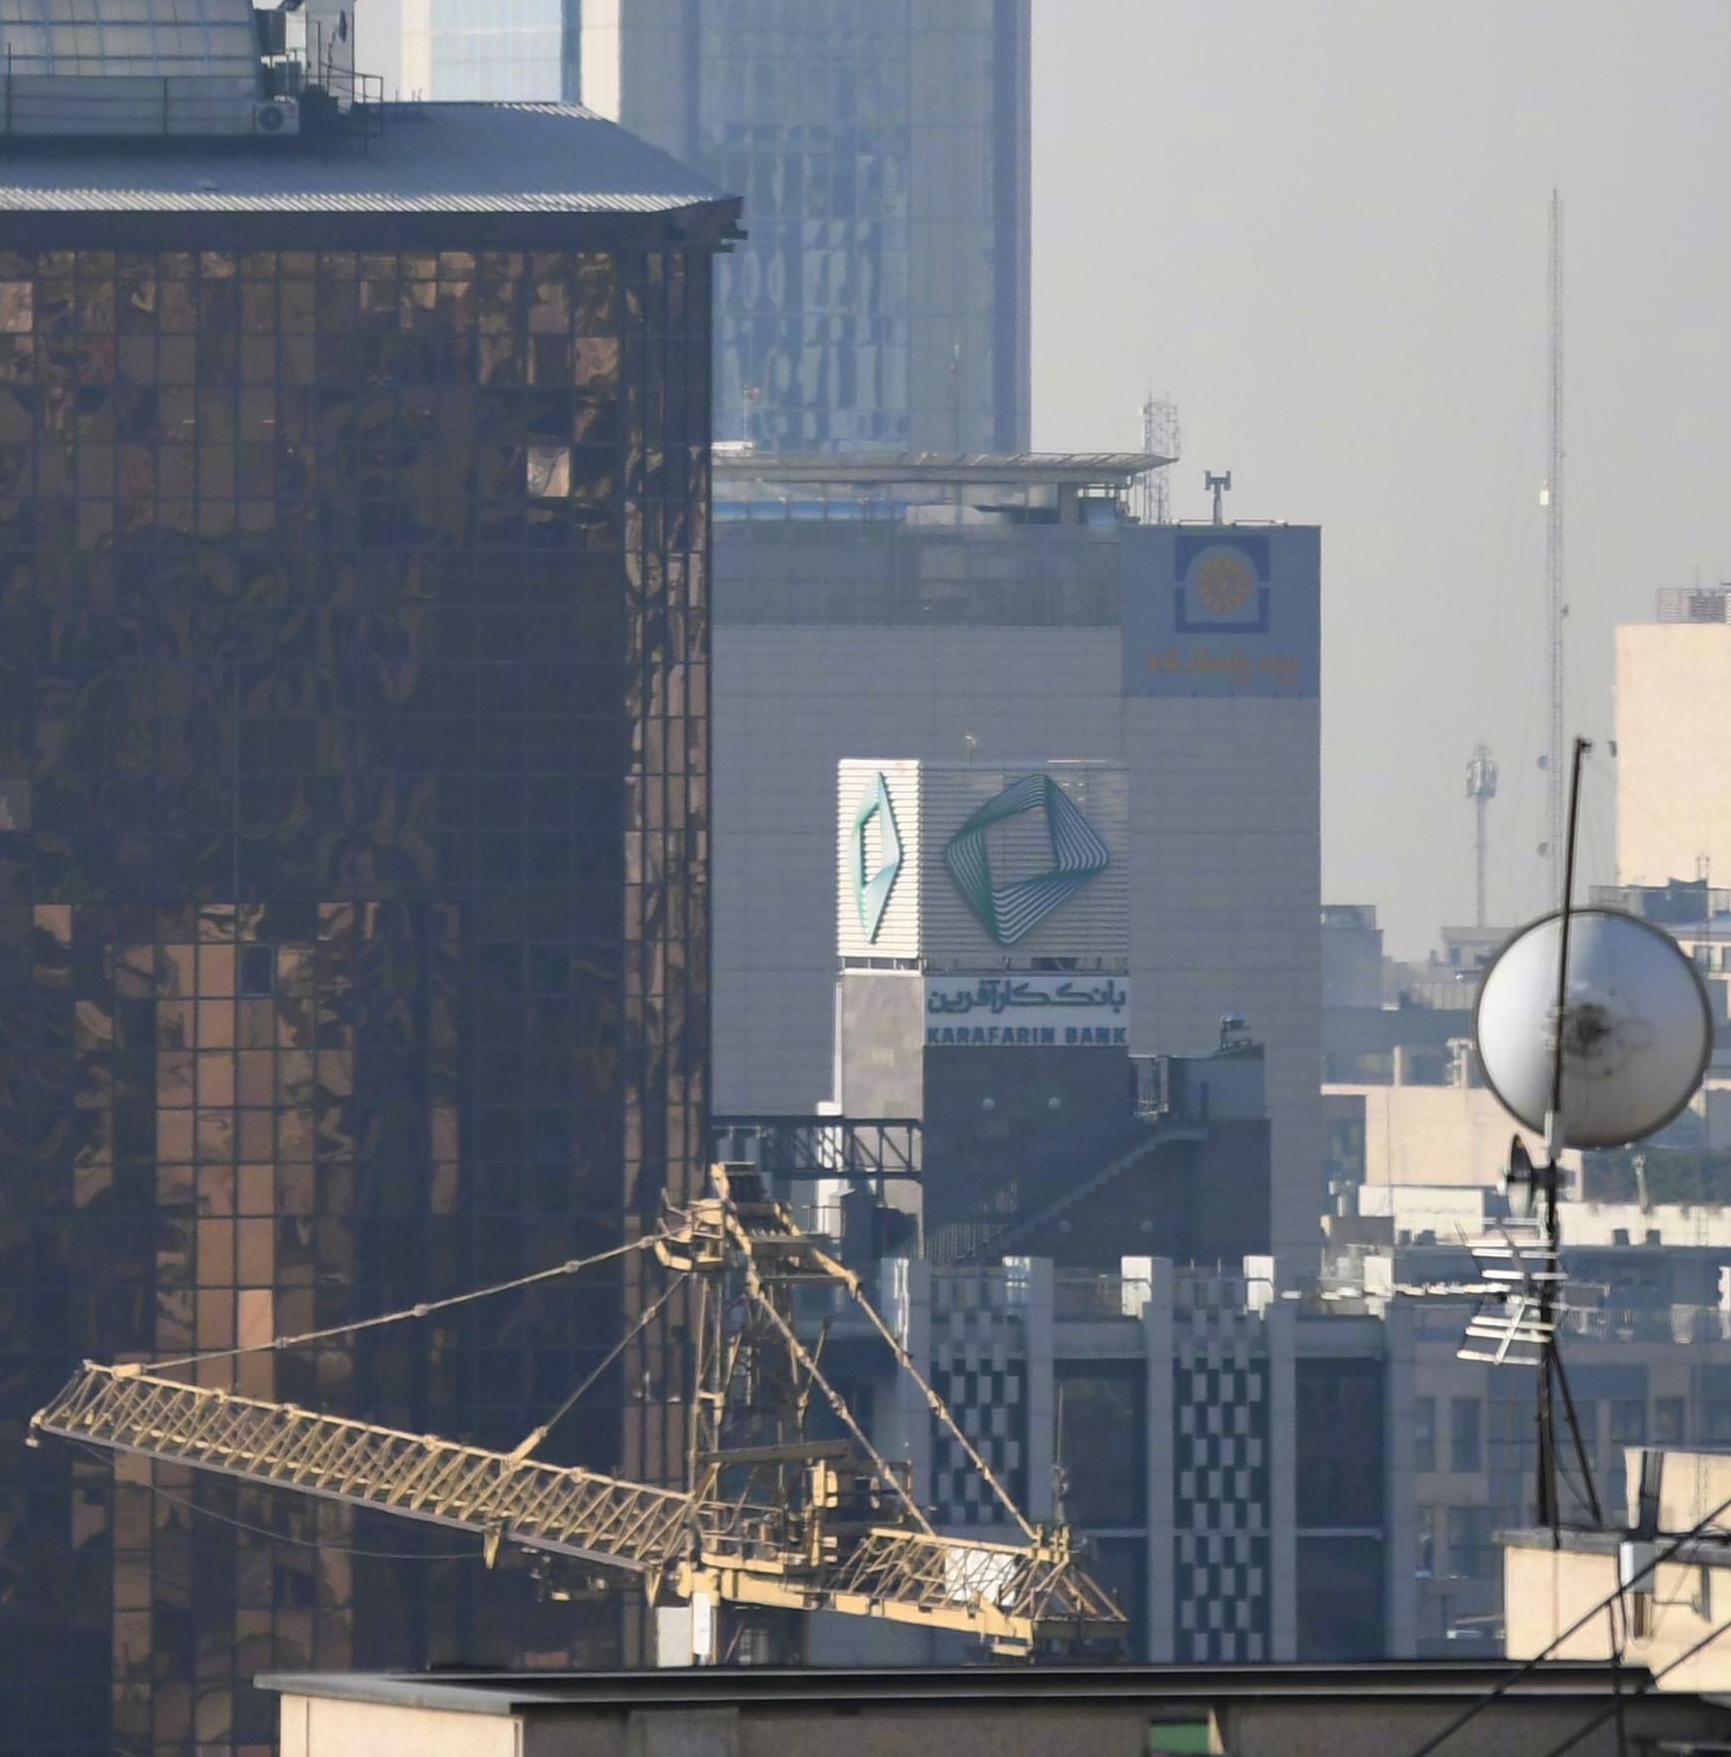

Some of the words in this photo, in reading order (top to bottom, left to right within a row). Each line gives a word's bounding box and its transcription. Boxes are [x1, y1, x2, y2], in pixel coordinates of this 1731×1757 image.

[927, 979, 1049, 1014] کارآفرین
[1049, 979, 1126, 1014] بانک
[927, 1026, 1056, 1044] KARAFARIN
[1065, 1026, 1127, 1044] BANK
